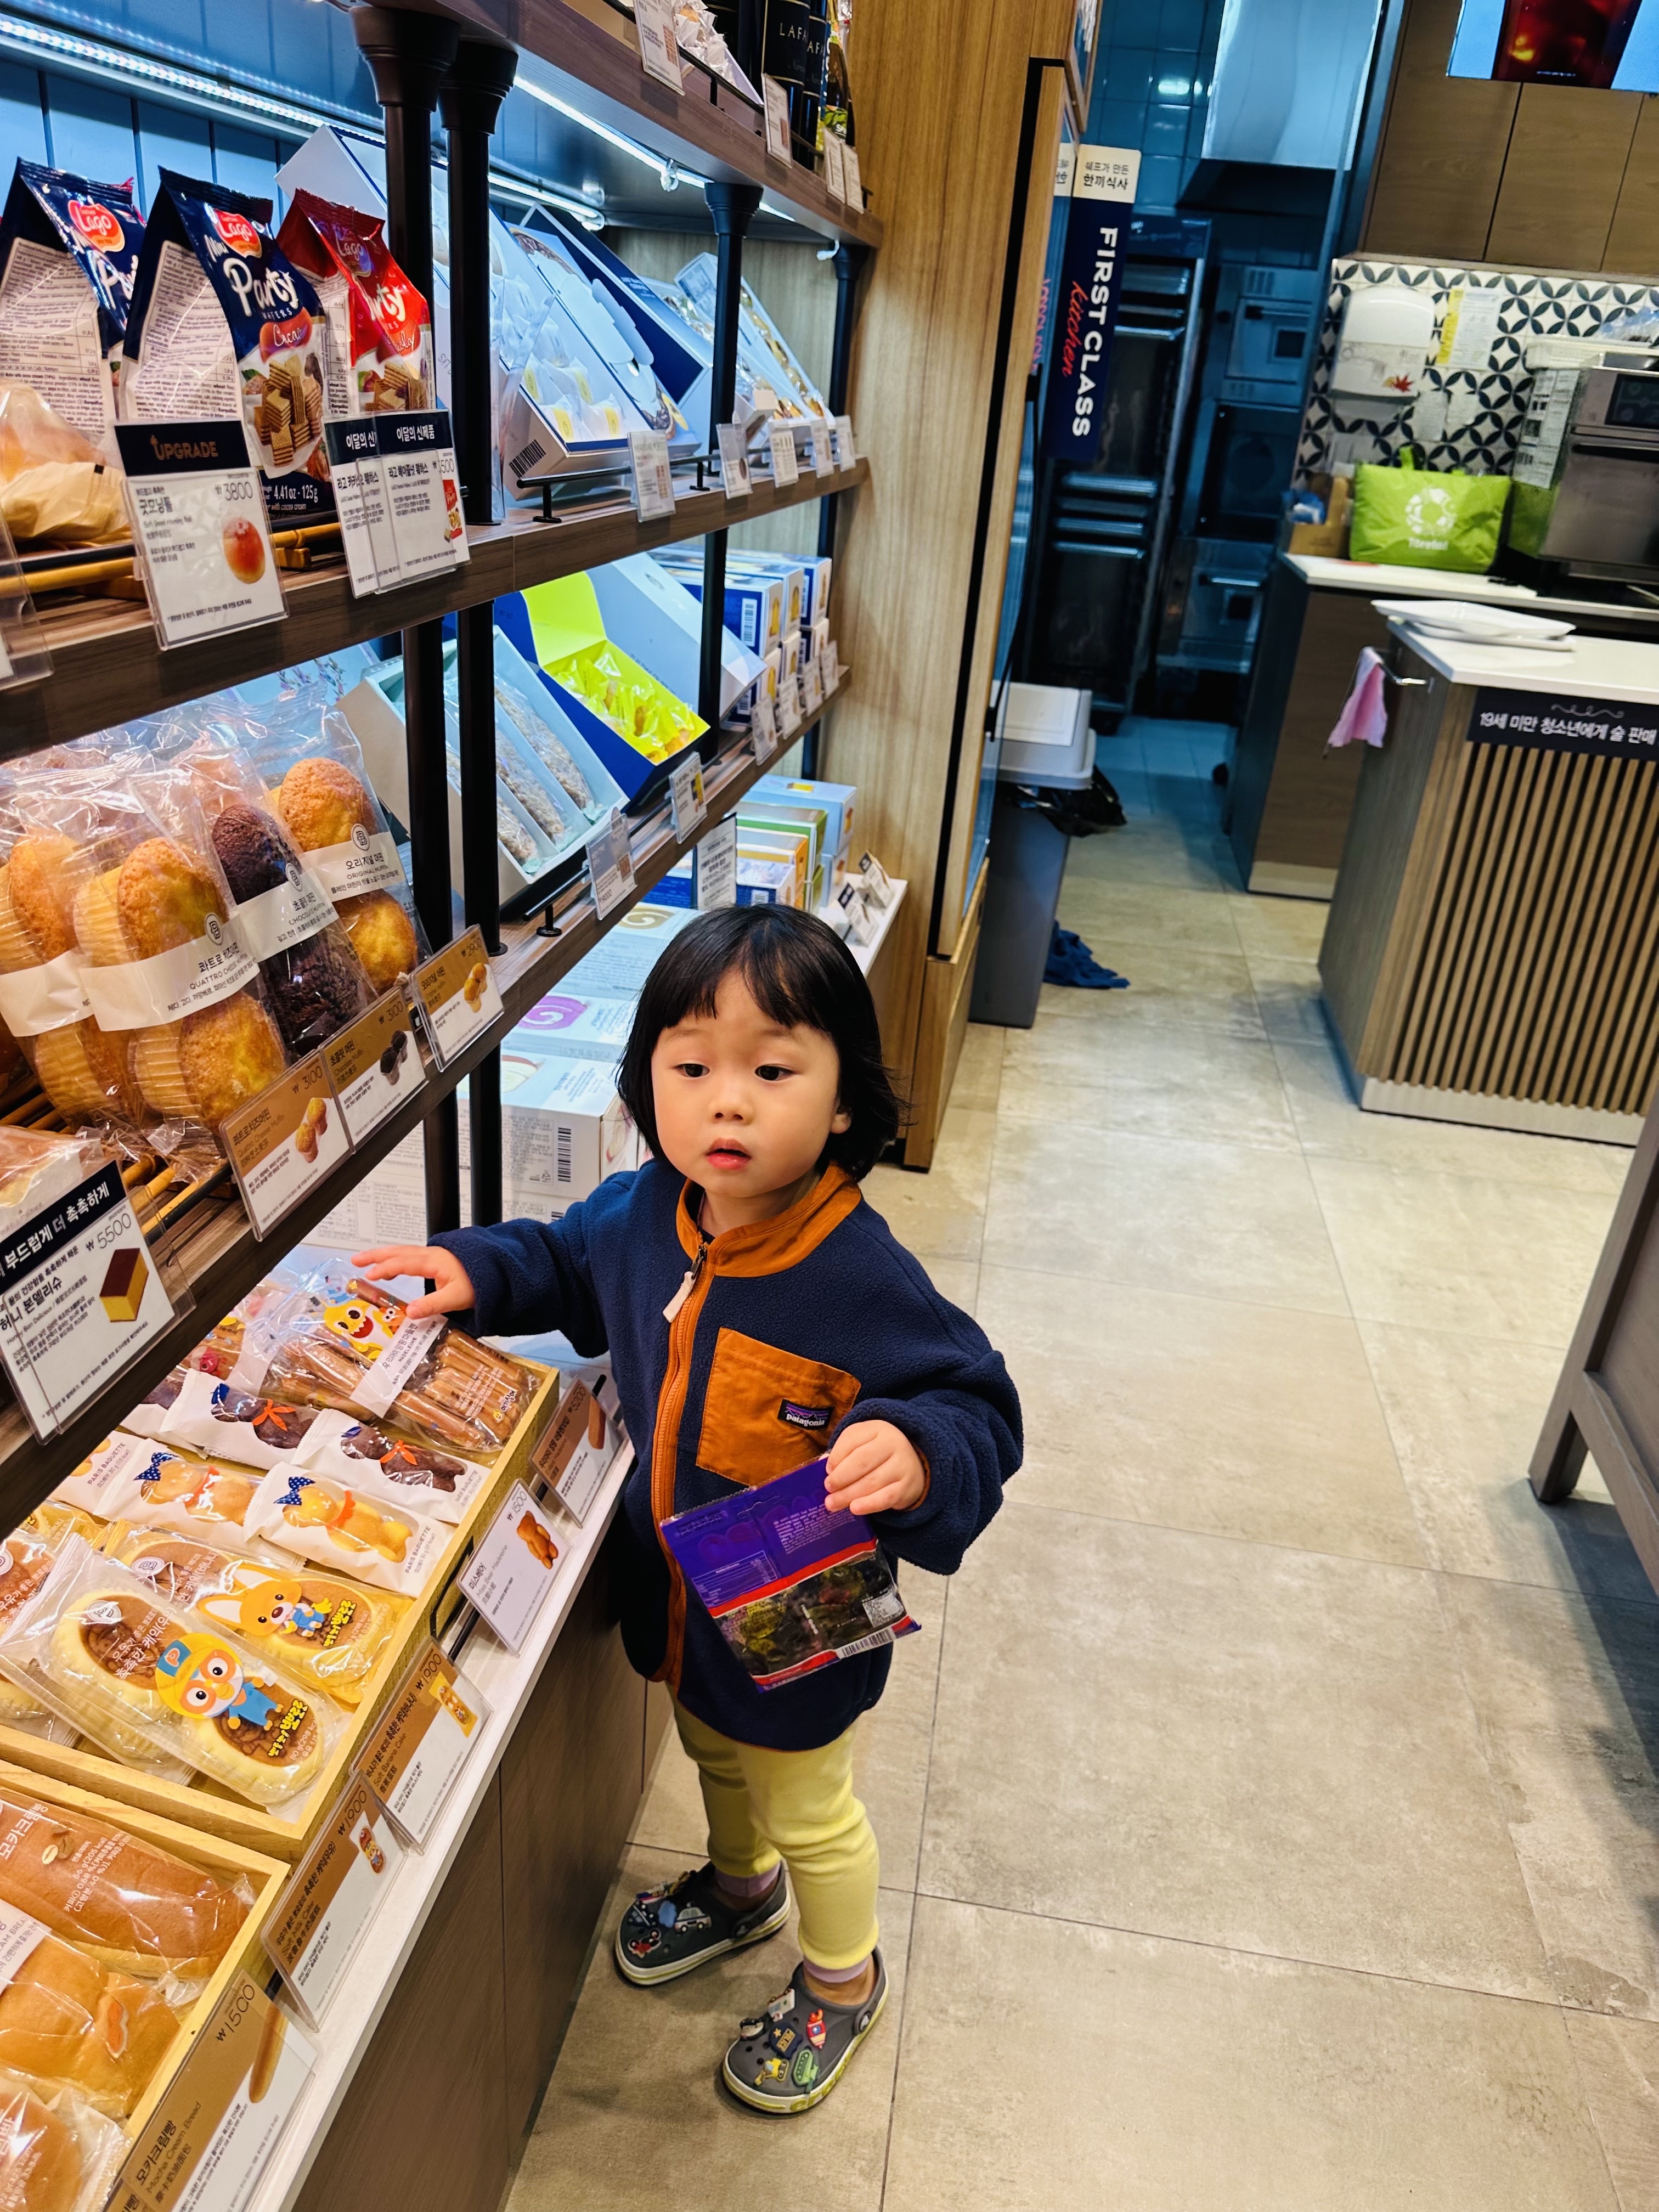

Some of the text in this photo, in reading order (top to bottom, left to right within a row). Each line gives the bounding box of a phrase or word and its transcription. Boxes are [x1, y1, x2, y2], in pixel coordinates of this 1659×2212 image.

[78, 213, 111, 236] Lago
[221, 223, 252, 241] Lago
[223, 257, 298, 317] Party
[262, 308, 292, 320] WAFERS
[1073, 227, 1118, 437] FIRST CLASS
[346, 432, 367, 450] 이달의
[396, 424, 435, 442] 이달의 신제품
[152, 437, 219, 461] UPGRADE
[337, 476, 348, 490] 라고
[388, 466, 398, 479] 라고
[1480, 712, 1508, 730] 19세
[1509, 714, 1538, 732] 미만
[1540, 716, 1610, 741] 청소년에게
[1609, 725, 1626, 742] 술
[346, 854, 375, 870] 오리지널
[347, 868, 375, 879] ORIGINAL
[466, 937, 483, 957] 2900
[198, 953, 224, 973] 콰트로
[190, 970, 223, 990] QUATTRO
[386, 1000, 404, 1022] 3100
[302, 1065, 324, 1091] 3100
[5, 1181, 111, 1269] 부드럽게 더 촉촉하게
[97, 1212, 132, 1250] 5500
[43, 1254, 69, 1277] 촉촉하게
[0, 1274, 64, 1332] 허니 본델리슈
[398, 1336, 417, 1362] MADELEINE
[786, 1413, 826, 1427] patagonia
[87, 1441, 126, 1485] PARIS BAGUETTE
[461, 1469, 478, 1492] BAGUETTE
[404, 1525, 431, 1574] PARIS BAGUETTE
[467, 1562, 487, 1590] 미스베어
[110, 1623, 147, 1663] 우유가 좋은
[114, 1604, 178, 1681] 촉촉한 케익(우유)
[384, 1719, 402, 1741] 촉촉한
[371, 1731, 407, 1787] Soft Banana Cake
[0, 1798, 49, 1860] 모카크림빵
[80, 1835, 108, 1870] g(205 kcal)
[76, 1871, 92, 1891] 0.68
[88, 1874, 100, 1887] 40
[302, 1871, 321, 1897] 촉촉한
[280, 1900, 316, 1953] Soft Milk Cake
[3, 1938, 23, 1963] 간편하게
[133, 2118, 179, 2186] 모카크림빵
[144, 2100, 204, 2194] Mocha Cream Bread
